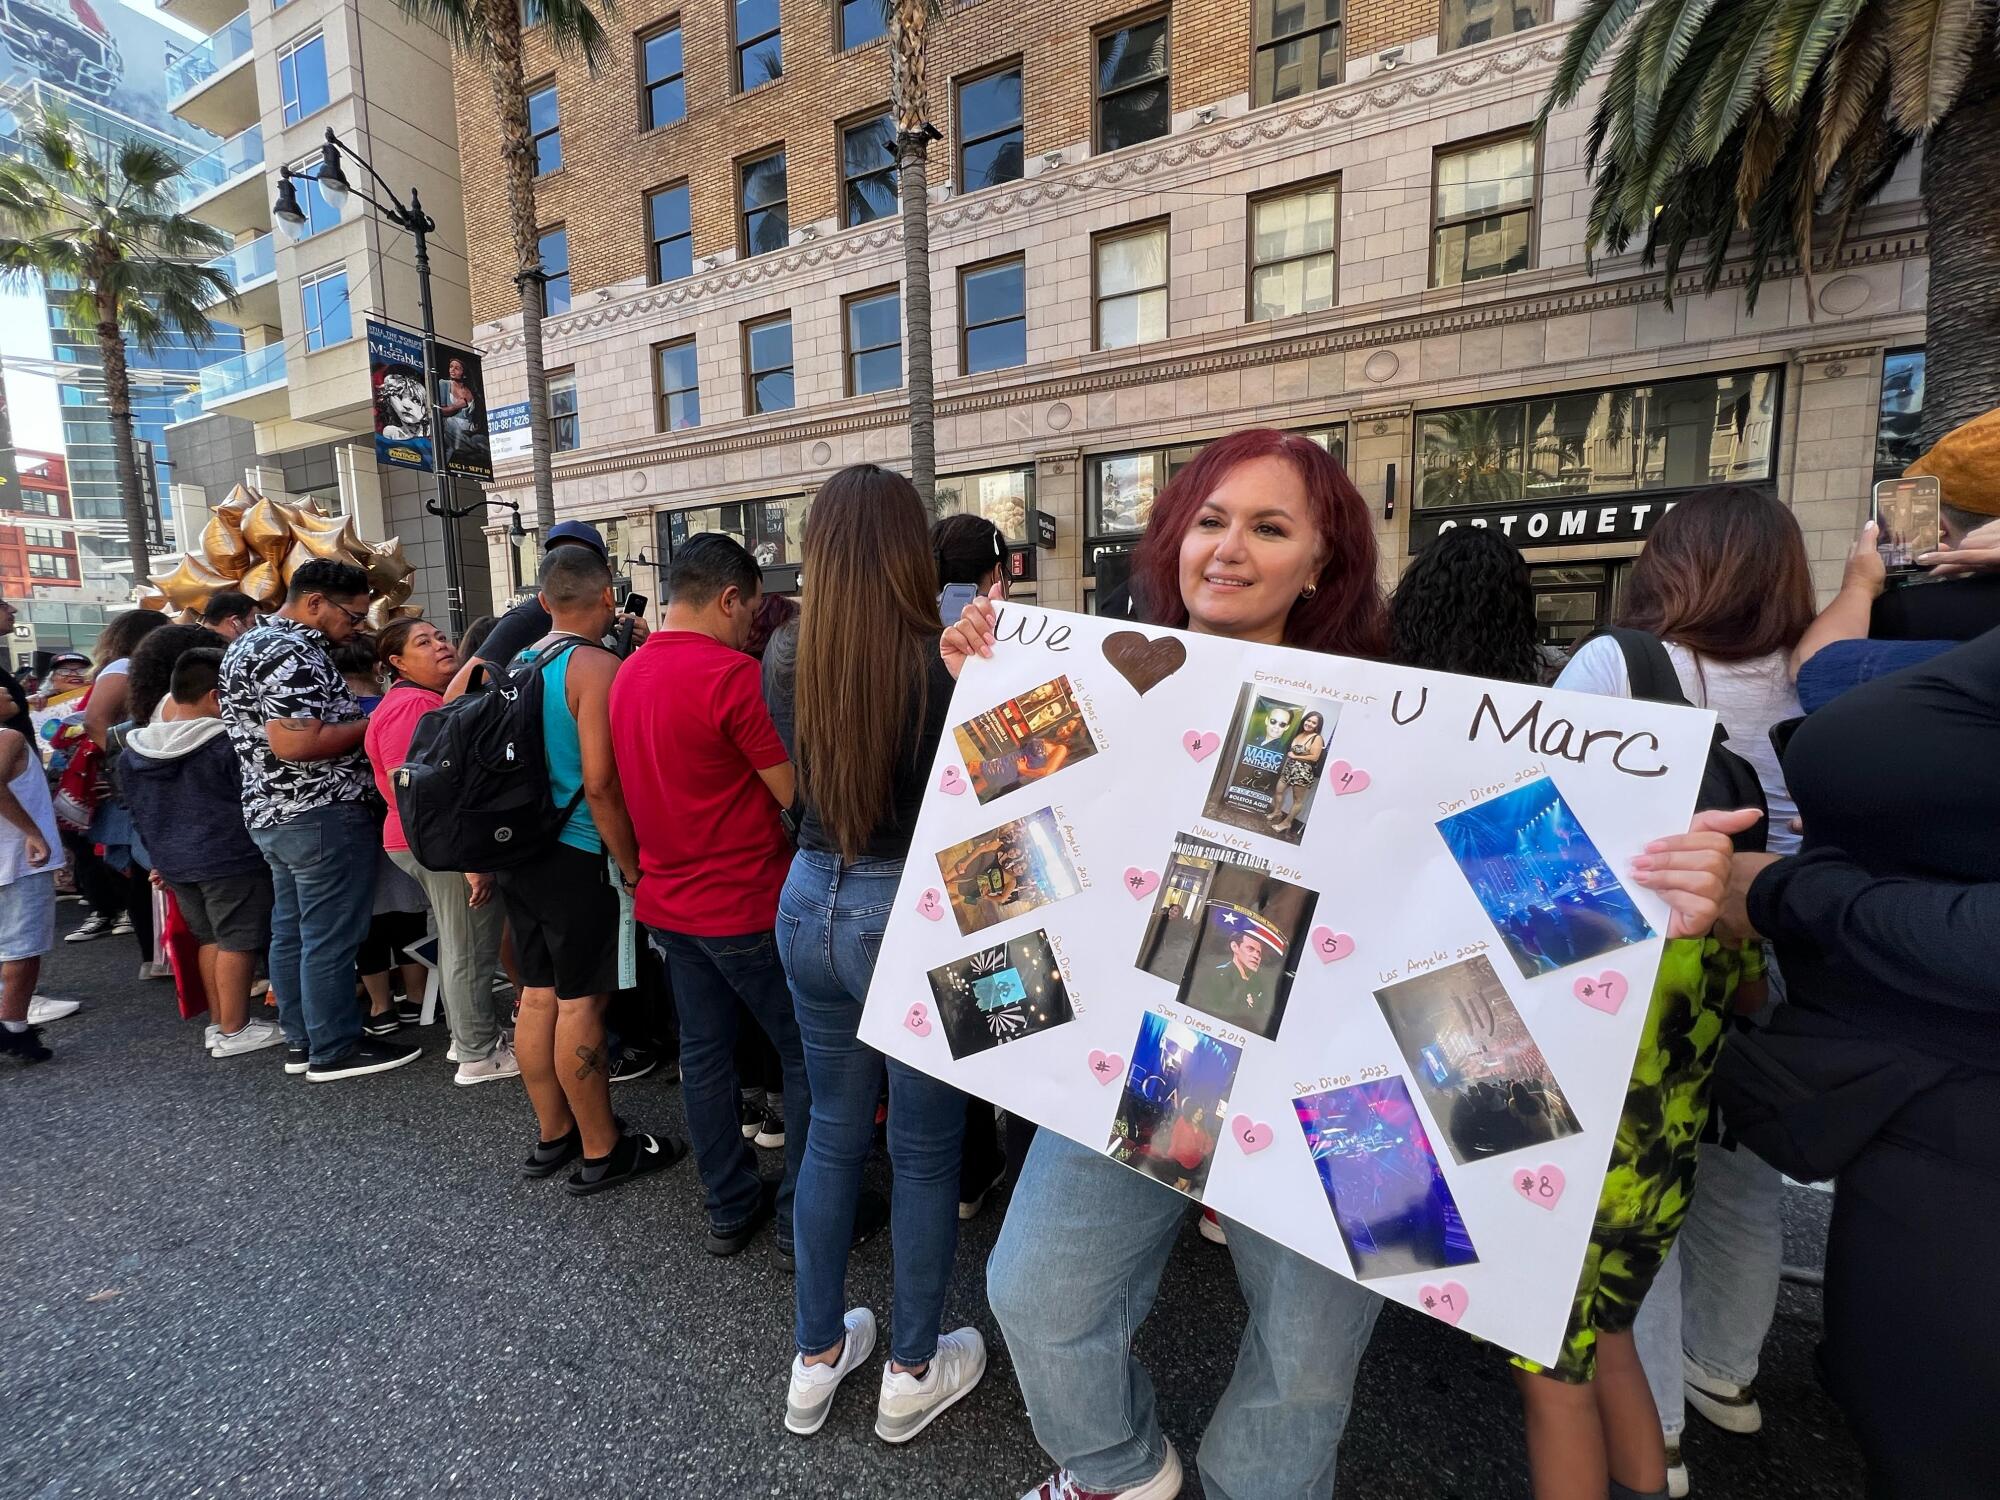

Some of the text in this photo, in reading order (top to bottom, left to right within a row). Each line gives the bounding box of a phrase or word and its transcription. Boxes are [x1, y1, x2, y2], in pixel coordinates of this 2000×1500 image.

[386, 331, 397, 339] THE
[487, 414, 530, 432] 310-887-6226
[1438, 503, 1679, 538] TOMET
[993, 607, 1072, 652] We
[1254, 670, 1318, 697] Ensenada,
[1343, 691, 1378, 706] 2015
[1081, 694, 1098, 722] Vegas
[1468, 693, 1669, 778] Marc
[1242, 755, 1280, 771] ANTHONY
[1244, 746, 1283, 765] MARC
[1340, 772, 1354, 792] 4
[1438, 761, 1548, 816] San Diego 2021
[1192, 824, 1253, 850] New York
[1203, 847, 1237, 865] SQUARE
[1076, 864, 1093, 889] 2013
[1129, 876, 1145, 890] #
[1275, 865, 1303, 881] 2016
[1321, 937, 1338, 954] 5
[1406, 950, 1449, 974] Angeles
[1456, 941, 1491, 960] 2022
[1069, 991, 1087, 1015] 2014
[1156, 1004, 1248, 1048] San Diego 2019
[1095, 1060, 1112, 1074] #
[1293, 1081, 1317, 1096] San
[1360, 1064, 1390, 1081] 2023
[1243, 1129, 1256, 1144] 6
[1520, 1175, 1554, 1198] #8
[1423, 1293, 1455, 1311] #9
